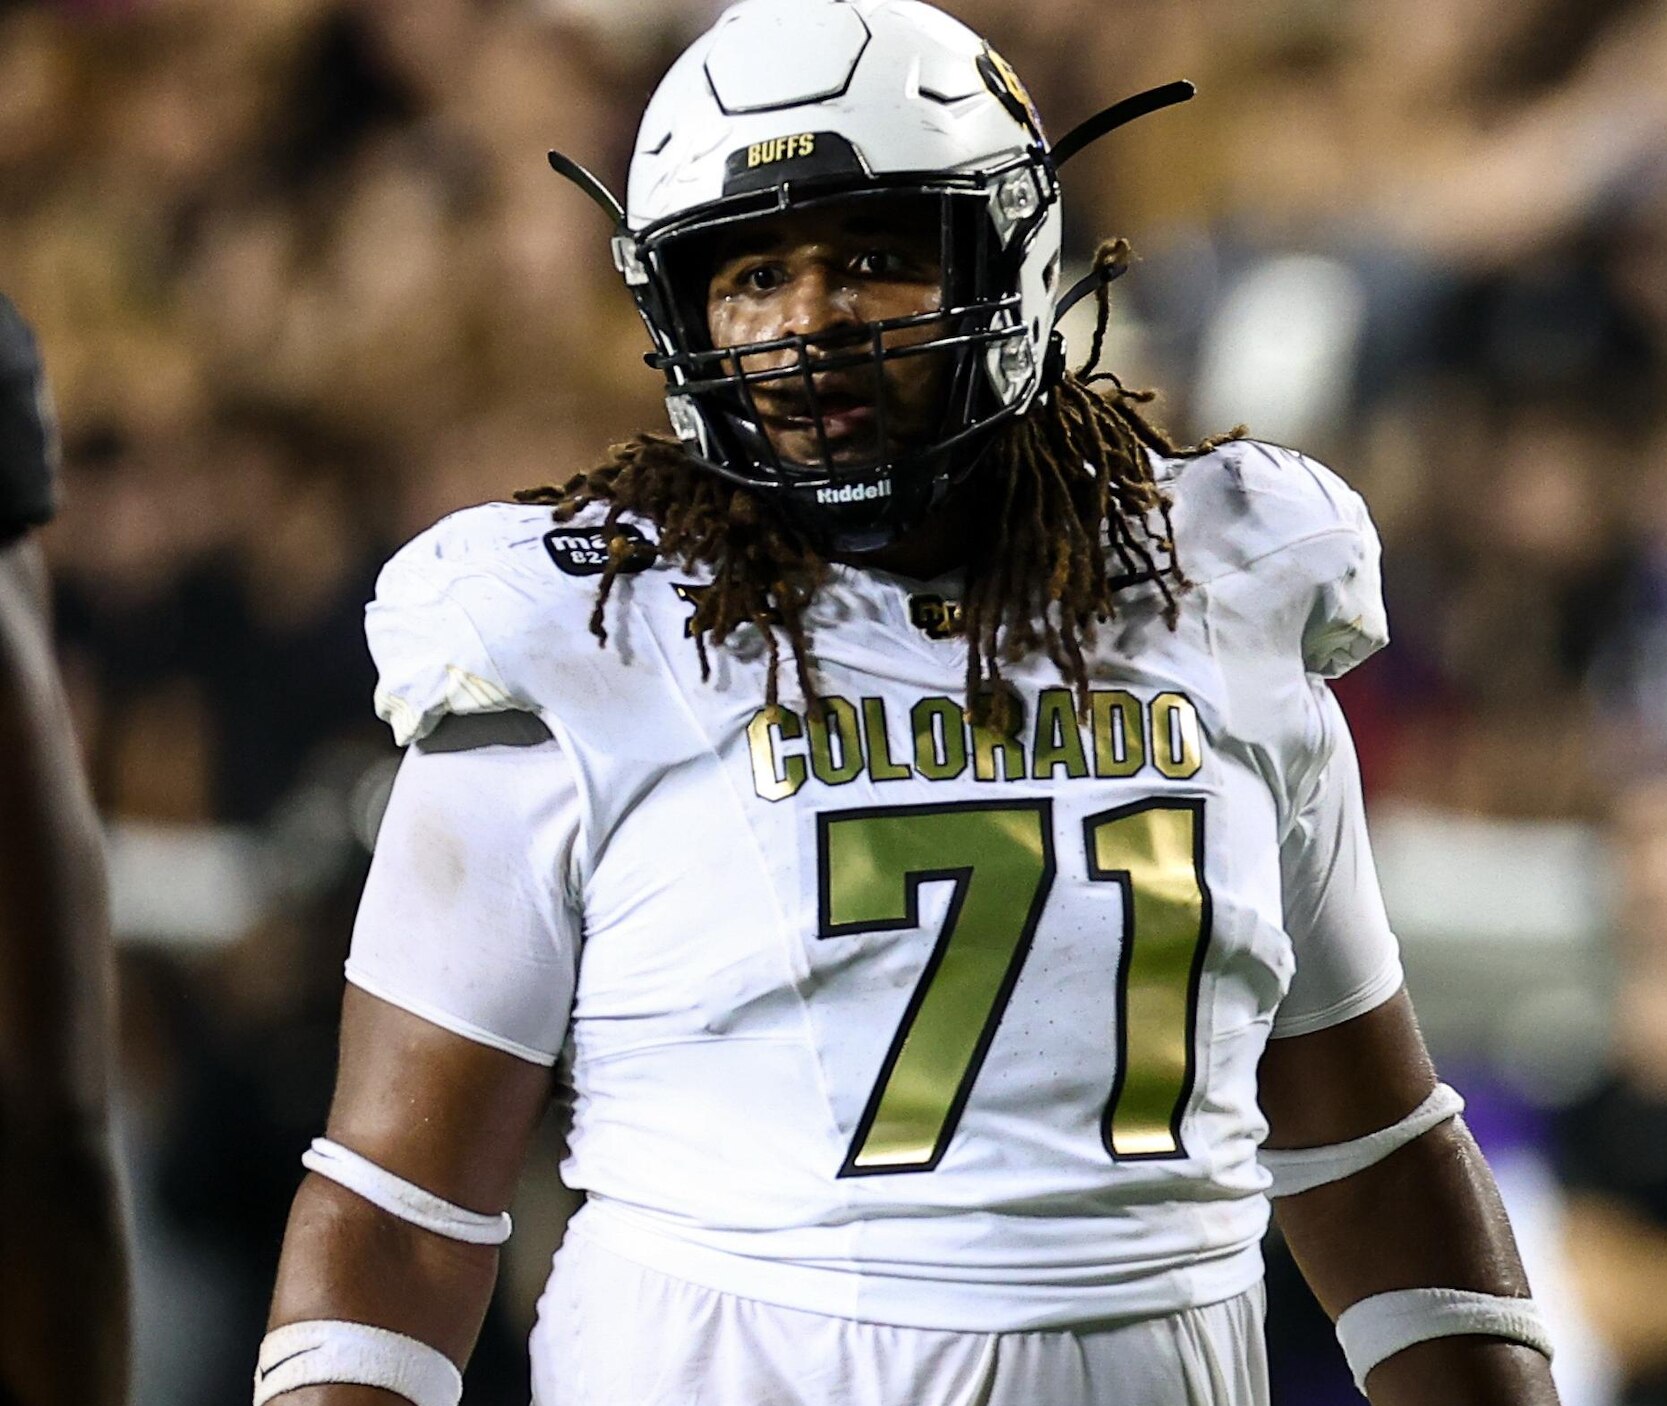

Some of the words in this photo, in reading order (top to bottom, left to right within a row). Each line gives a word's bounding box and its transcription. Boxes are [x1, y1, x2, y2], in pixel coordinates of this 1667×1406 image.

[747, 132, 815, 168] BUFFS
[746, 689, 1203, 801] COLORADO
[816, 797, 1213, 1178] 71
